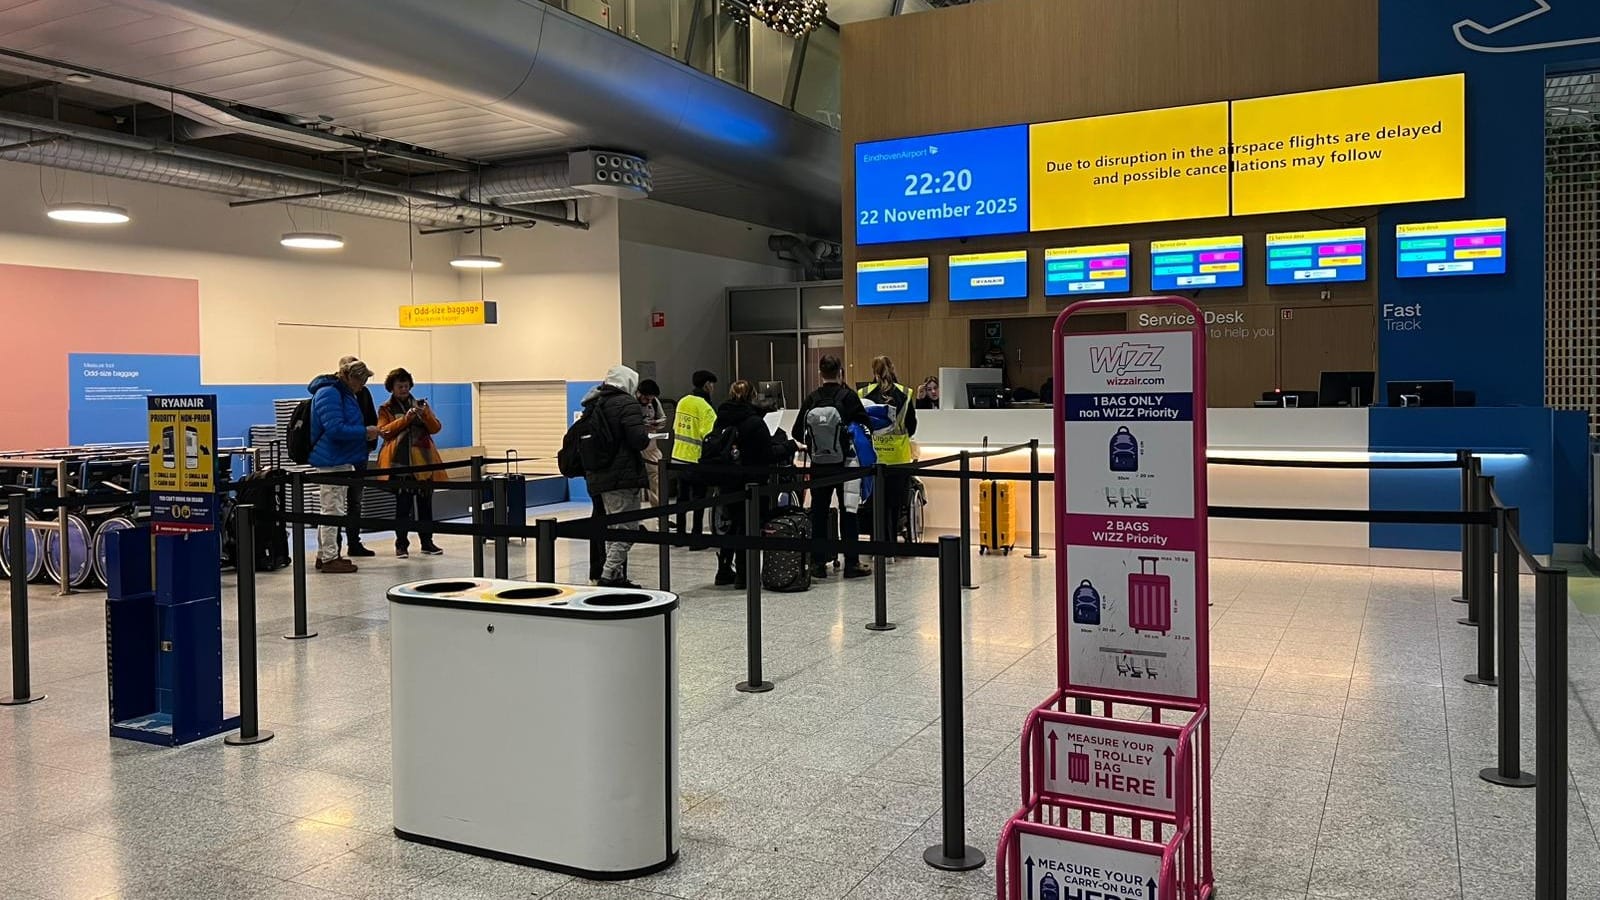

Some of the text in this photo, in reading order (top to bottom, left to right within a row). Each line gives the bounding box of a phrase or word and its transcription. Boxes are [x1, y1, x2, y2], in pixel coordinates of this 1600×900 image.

[1046, 120, 1442, 173] Due to disruption in the airspace flights are delayed
[863, 149, 928, 162] EindhovenAirport
[1093, 148, 1382, 185] and possible cancellations may follow
[904, 168, 973, 196] 22:20
[860, 197, 1018, 225] 22 November 2025
[414, 305, 479, 315] Odd-size baggage
[1383, 303, 1422, 317] Fast
[1139, 310, 1245, 327] Service Desk
[1384, 318, 1422, 331] Track
[1210, 327, 1275, 338] to help you
[83, 369, 139, 378] Odd-size baggage
[1106, 377, 1165, 386] wizzair.com
[161, 397, 204, 408] RYANAIR
[1093, 396, 1163, 406] 1 BAG ONLY
[150, 413, 177, 422] PRIORITY
[180, 413, 211, 422] NON-PRIOR
[1079, 407, 1179, 419] non WIZZ Priority
[1106, 520, 1150, 532] 2 BAGS
[1092, 531, 1168, 546] WIZZ Priority
[1067, 732, 1154, 752] MEASURE YOUR
[1094, 748, 1152, 766] TROLLEY
[1094, 760, 1121, 773] BAG
[1095, 771, 1156, 797] HERE
[1038, 858, 1143, 886] MEASURE YOUR
[1064, 875, 1143, 897] CARRY-ON BAG
